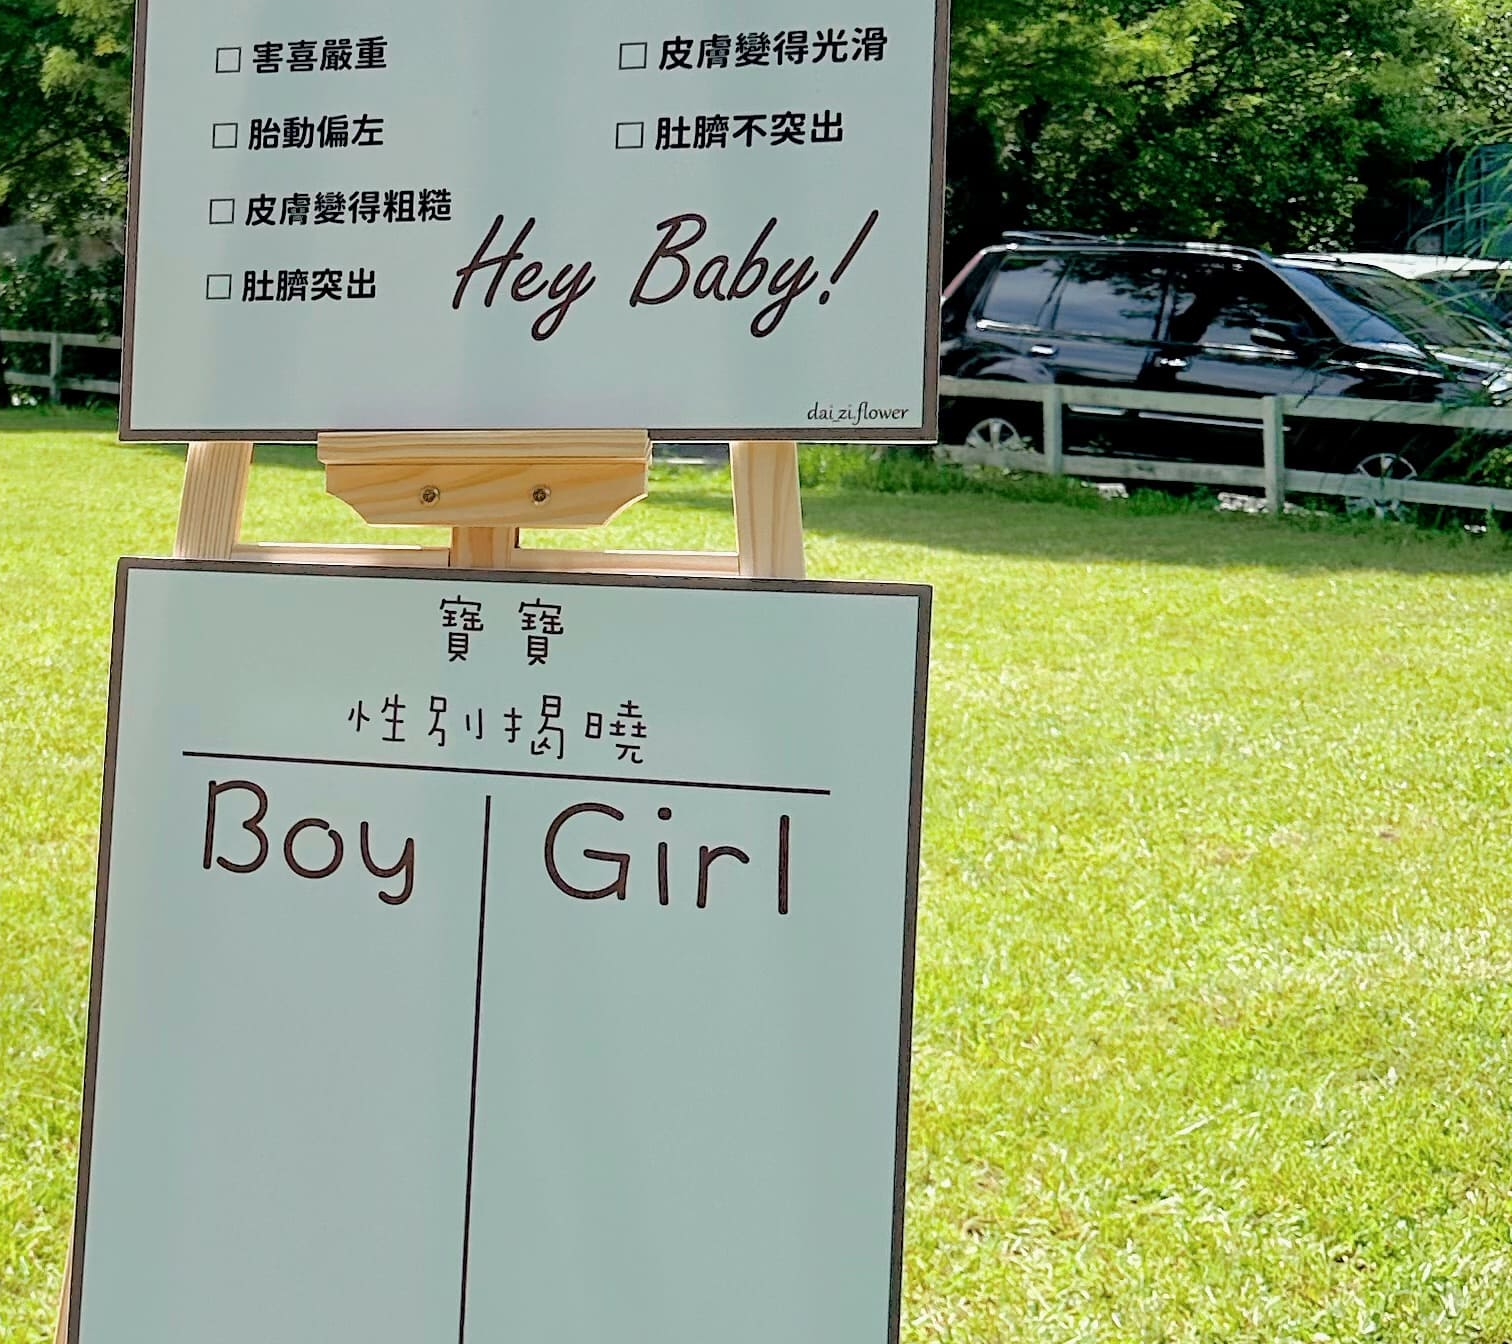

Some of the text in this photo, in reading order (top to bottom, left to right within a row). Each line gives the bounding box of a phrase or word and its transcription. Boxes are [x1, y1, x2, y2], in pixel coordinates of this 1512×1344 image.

[253, 36, 387, 73] 害喜嚴重
[659, 27, 887, 70] 皮膚變得光滑
[248, 114, 383, 150] 胎動偏左
[655, 110, 843, 150] 肚臍不突出
[245, 189, 451, 226] 皮膚變得粗糙
[242, 268, 375, 302] 肚臍突出
[453, 210, 878, 341] Hey Baby!
[203, 780, 414, 905] Boy
[544, 803, 790, 915] Girl
